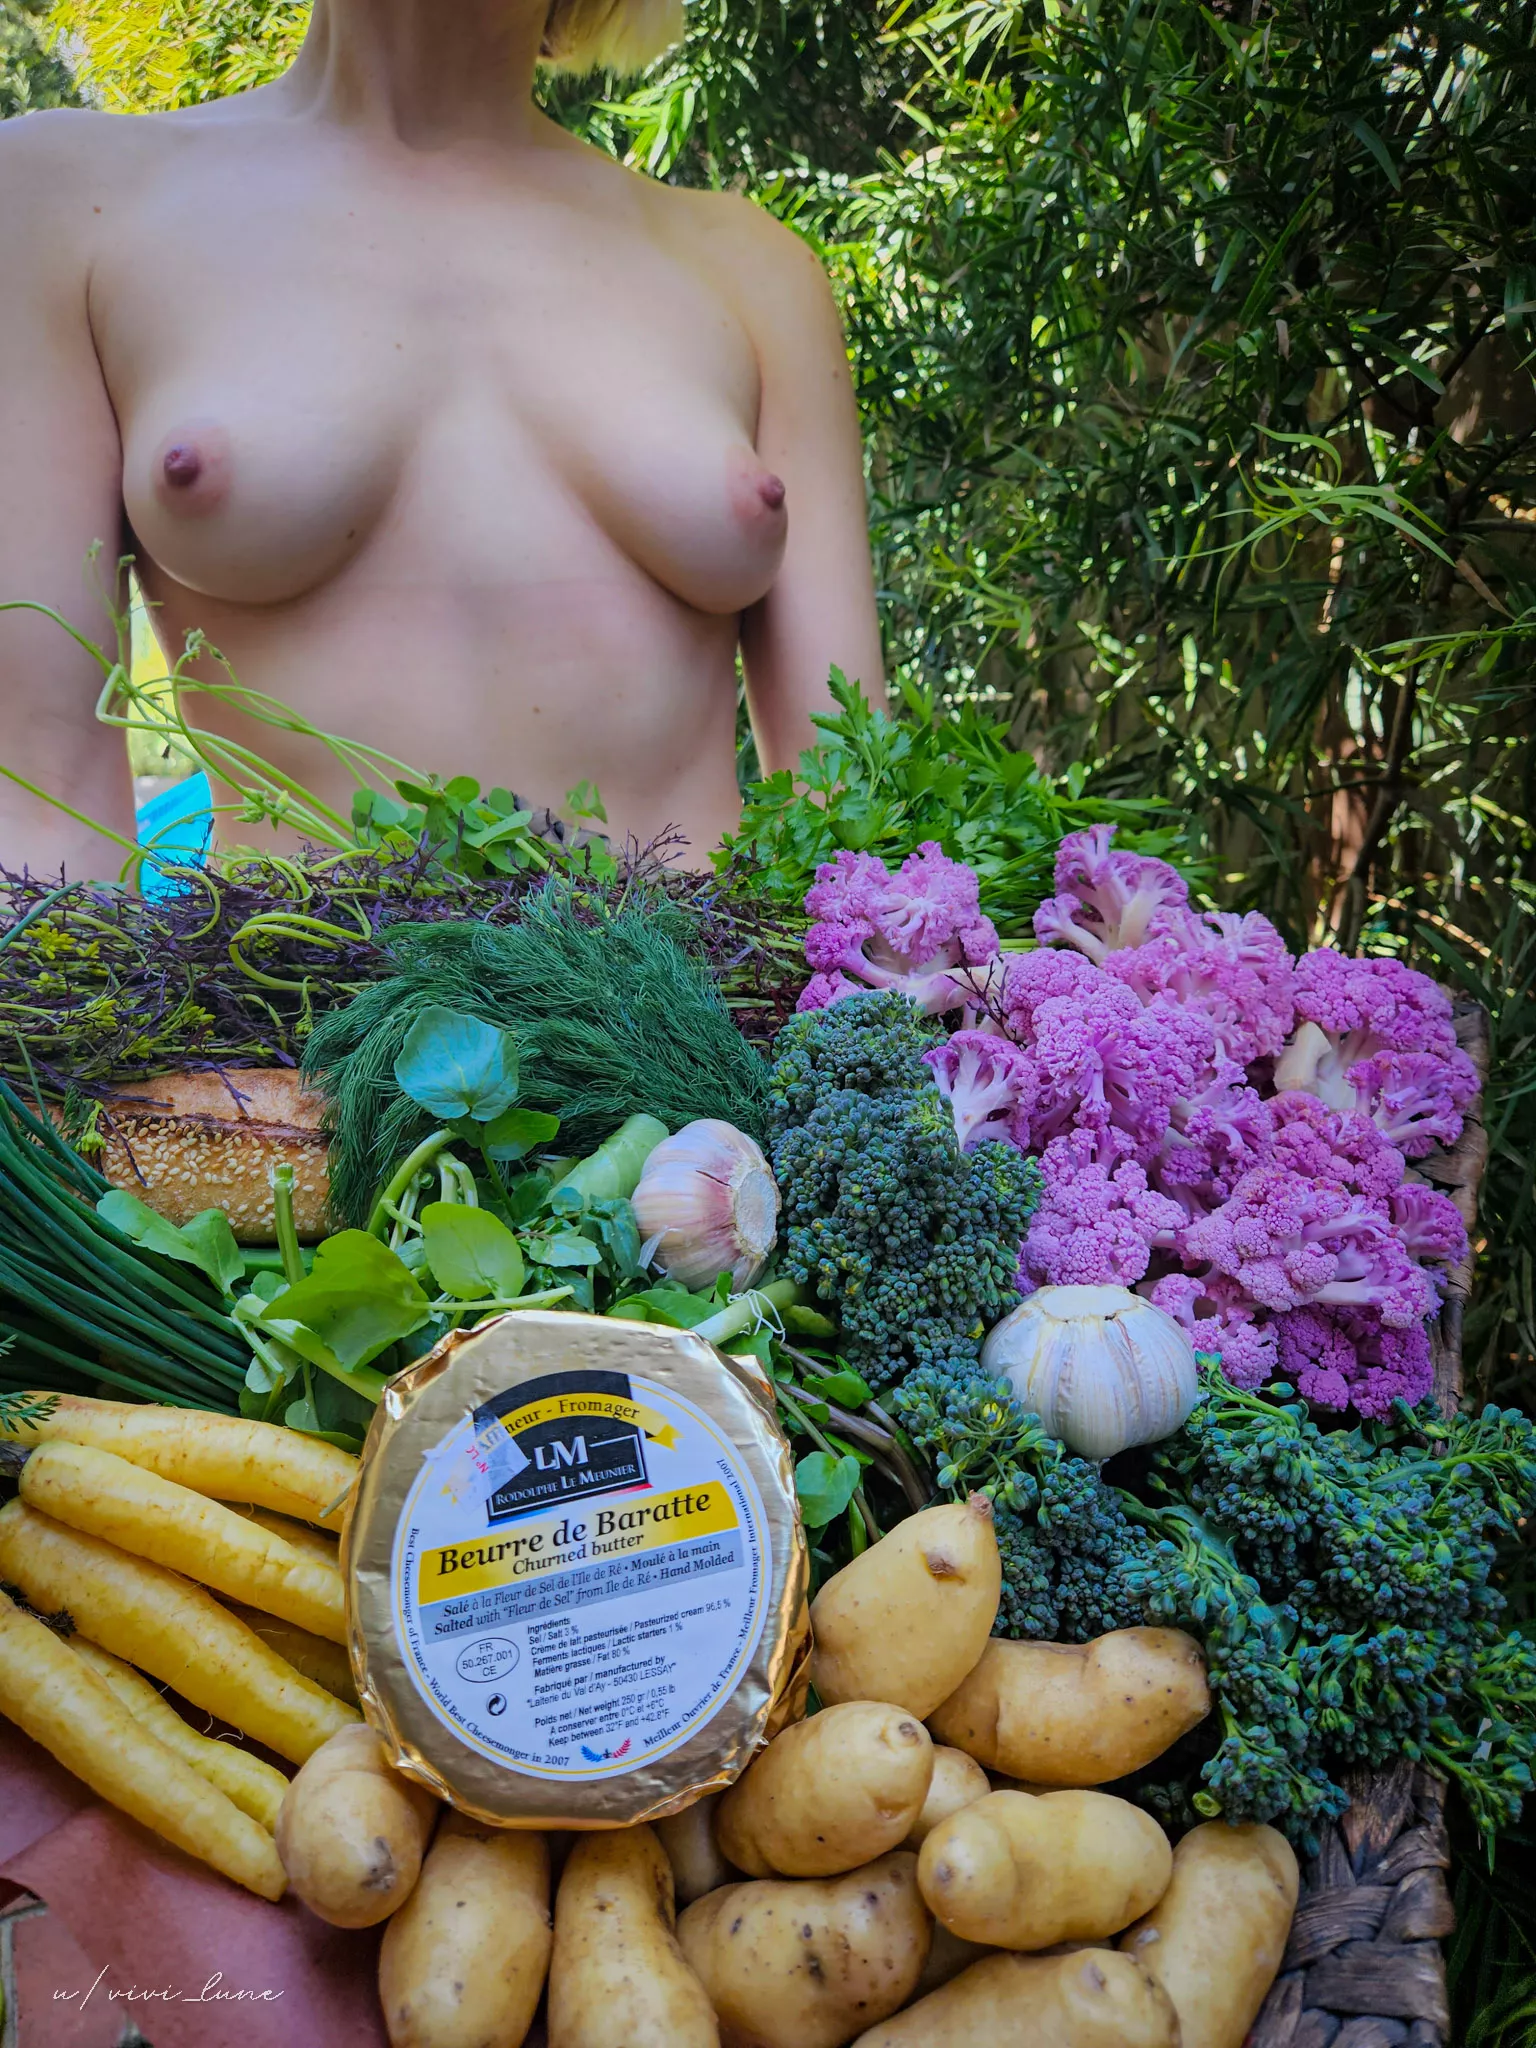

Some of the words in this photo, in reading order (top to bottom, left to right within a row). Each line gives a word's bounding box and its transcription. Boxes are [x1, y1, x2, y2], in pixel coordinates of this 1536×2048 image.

[559, 1399, 640, 1421] Fromager
[534, 1435, 589, 1471] LM
[716, 1458, 735, 1479] 2007
[730, 1480, 756, 1543] International
[408, 1528, 420, 1549] Best
[437, 1532, 544, 1576] Beurre
[553, 1518, 588, 1547] de
[596, 1492, 712, 1537] Baratte
[513, 1544, 587, 1575] Churned
[592, 1534, 644, 1555] butter
[444, 1601, 469, 1617] Salé
[472, 1600, 480, 1611] à
[482, 1596, 491, 1608] la
[494, 1591, 522, 1606] Fleur
[524, 1584, 537, 1597] de
[540, 1578, 554, 1593] Sel
[558, 1576, 570, 1589] de
[594, 1568, 605, 1580] de
[608, 1563, 622, 1578] Ré
[631, 1554, 666, 1572] Moulé
[669, 1552, 677, 1562] à
[679, 1548, 689, 1559] la
[691, 1541, 721, 1555] main
[749, 1548, 760, 1594] Fromager
[402, 1552, 414, 1625] Cheesemonger
[434, 1616, 473, 1635] Salted
[476, 1610, 501, 1626] with
[540, 1597, 551, 1610] de
[576, 1586, 603, 1604] from
[606, 1581, 620, 1594] Ile
[622, 1576, 635, 1589] de
[638, 1572, 651, 1585] Ré
[660, 1563, 691, 1580] Hand
[694, 1551, 735, 1571] Molded
[409, 1627, 418, 1638] of
[558, 1640, 568, 1649] de
[570, 1636, 582, 1647] lait
[584, 1625, 628, 1643] pasteurisée
[634, 1610, 679, 1630] Pasteurized
[681, 1606, 704, 1619] cream
[723, 1598, 732, 1608] %
[738, 1597, 756, 1639] Meilleur
[479, 1642, 494, 1653] FR
[529, 1635, 542, 1645] Sel
[548, 1630, 563, 1641] Salt
[564, 1628, 570, 1637] 3
[571, 1625, 579, 1635] %
[532, 1651, 569, 1666] Ferments
[571, 1642, 606, 1660] lactiques
[612, 1634, 636, 1647] Lactic
[638, 1627, 667, 1641] starters
[669, 1624, 673, 1633] 1
[675, 1621, 683, 1632] %
[410, 1638, 429, 1673] France
[462, 1650, 513, 1670] 50.267.001
[482, 1666, 498, 1677] CE
[534, 1664, 563, 1678] Matière
[564, 1658, 591, 1673] grasse
[597, 1652, 610, 1662] Fat
[612, 1650, 621, 1659] 80
[622, 1646, 631, 1656] %
[718, 1646, 743, 1679] France
[534, 1677, 572, 1695] Fabriqué
[574, 1674, 588, 1687] par
[595, 1657, 653, 1680] manufactured
[655, 1656, 666, 1666] by
[562, 1688, 572, 1699] du
[574, 1686, 586, 1697] Val
[613, 1674, 638, 1687] 50430
[710, 1680, 722, 1693] de
[429, 1677, 451, 1708] World
[534, 1715, 557, 1728] Poids
[560, 1711, 572, 1721] net
[578, 1706, 592, 1716] Net
[594, 1698, 620, 1713] weight
[622, 1694, 635, 1706] 250
[638, 1693, 646, 1702] gr
[668, 1684, 676, 1693] lb
[681, 1691, 712, 1723] Ouvrier
[448, 1705, 467, 1725] Best
[550, 1726, 556, 1735] A
[558, 1717, 597, 1733] conserver
[600, 1710, 620, 1722] entre
[622, 1706, 635, 1717] 0°C
[637, 1703, 645, 1713] et
[466, 1722, 530, 1760] Cheesemonger
[548, 1735, 570, 1748] Keep
[572, 1728, 604, 1742] between
[606, 1720, 624, 1733] 32°F
[625, 1718, 639, 1728] and
[643, 1720, 682, 1748] Meilleur
[531, 1752, 542, 1763] in
[544, 1754, 571, 1766] 2007
